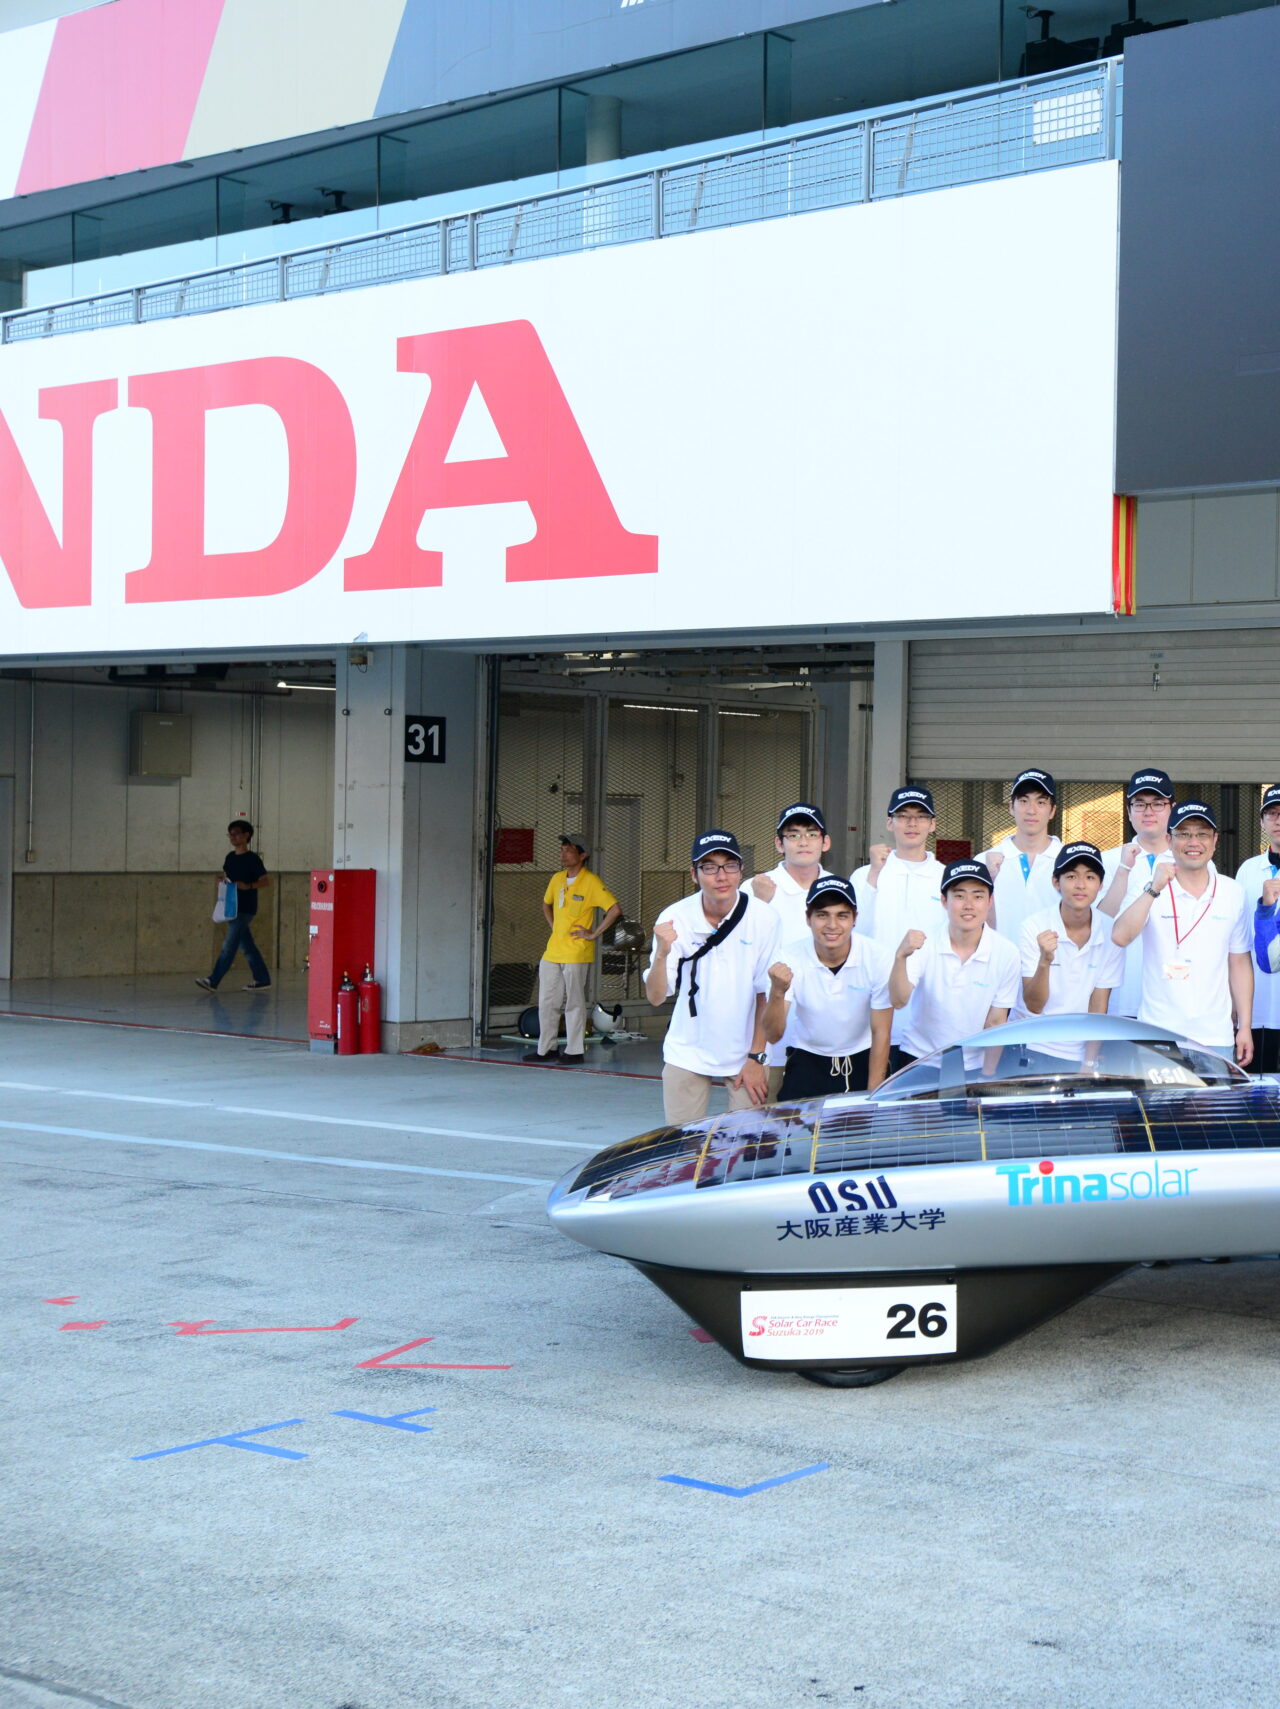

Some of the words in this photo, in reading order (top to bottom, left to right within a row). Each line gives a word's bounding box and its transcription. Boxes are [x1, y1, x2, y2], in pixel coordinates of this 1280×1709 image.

[407, 723, 440, 756] 31
[1135, 775, 1163, 784] EXEDY
[898, 791, 928, 800] EXEDY
[1177, 804, 1208, 814] EXEDY
[700, 834, 732, 845] EXEDY
[1066, 845, 1097, 854] EXEDY
[950, 865, 980, 876] EXEDY
[816, 879, 849, 889] EXEDY
[807, 1175, 898, 1214] OSU
[776, 1207, 946, 1241] 大阪産業大学
[768, 1319, 794, 1328] Solar
[796, 1319, 814, 1328] Car
[814, 1318, 838, 1327] Race
[886, 1302, 948, 1339] 26
[766, 1327, 801, 1337] Suzuka
[803, 1328, 825, 1336] 2019
